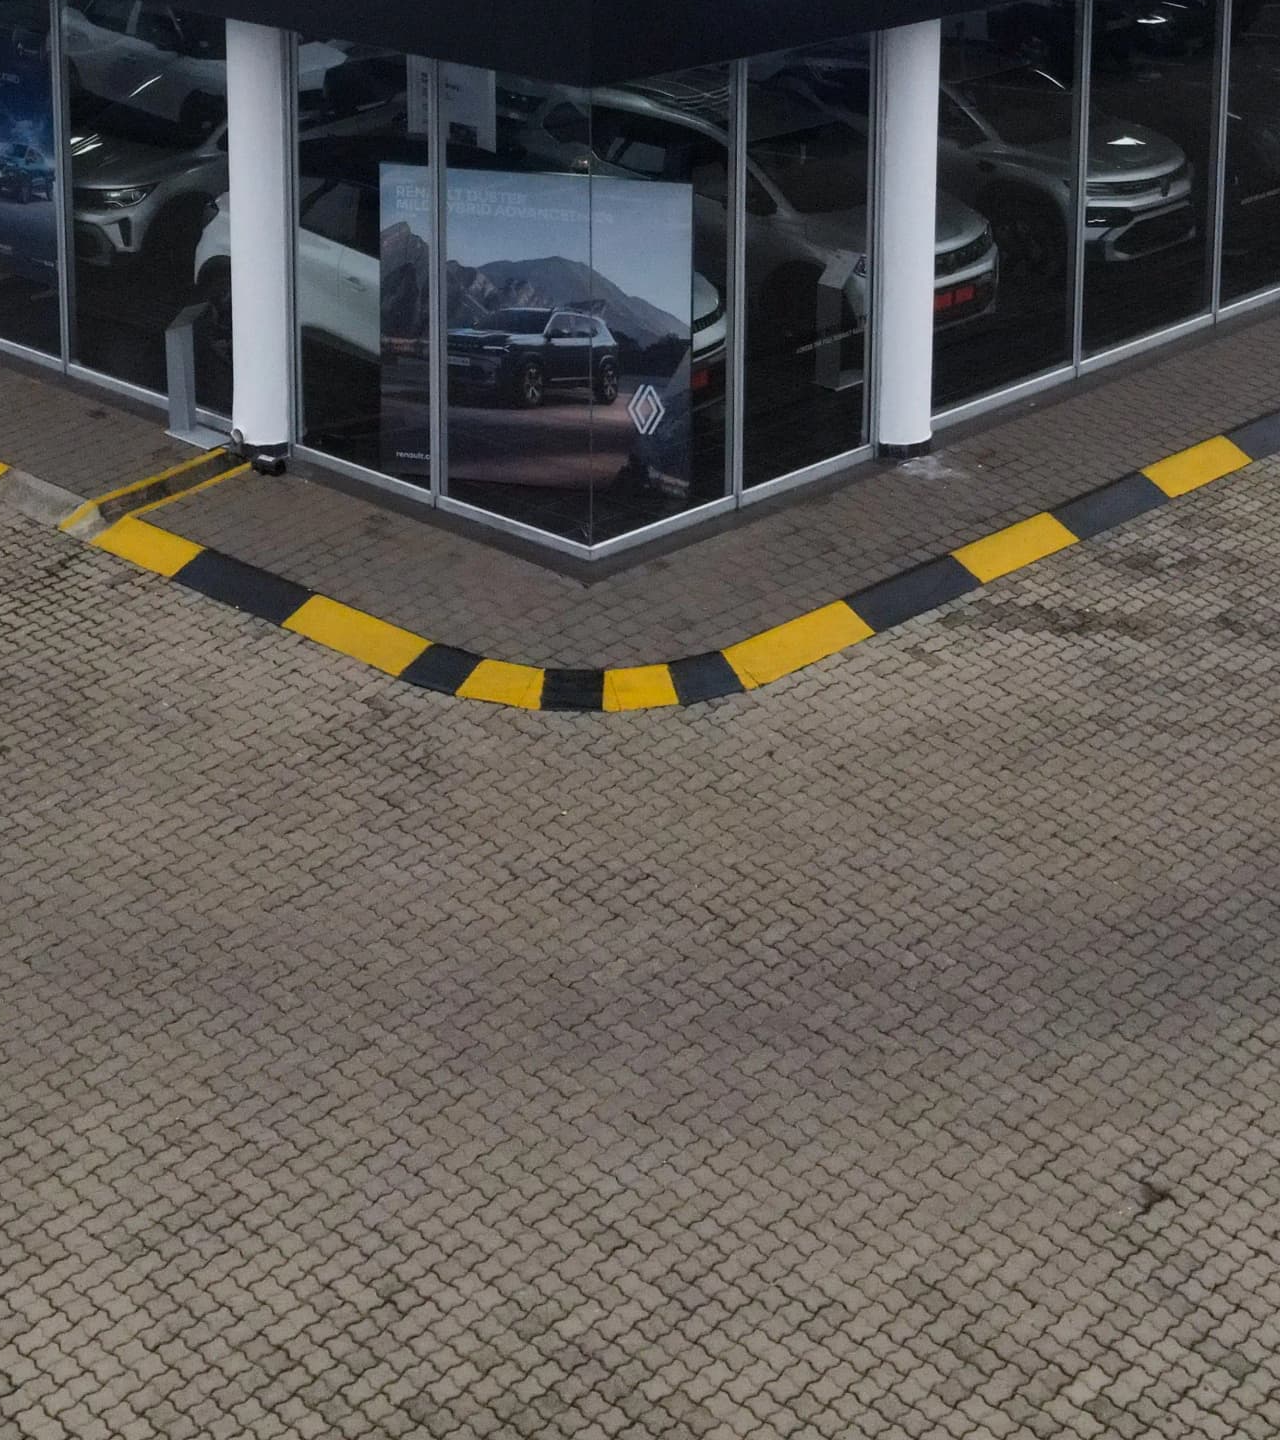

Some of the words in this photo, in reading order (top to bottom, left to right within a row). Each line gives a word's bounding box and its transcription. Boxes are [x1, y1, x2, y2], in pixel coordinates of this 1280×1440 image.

[395, 185, 462, 201] RENLT
[445, 201, 492, 216] YBRID
[395, 450, 431, 460] renault.c
